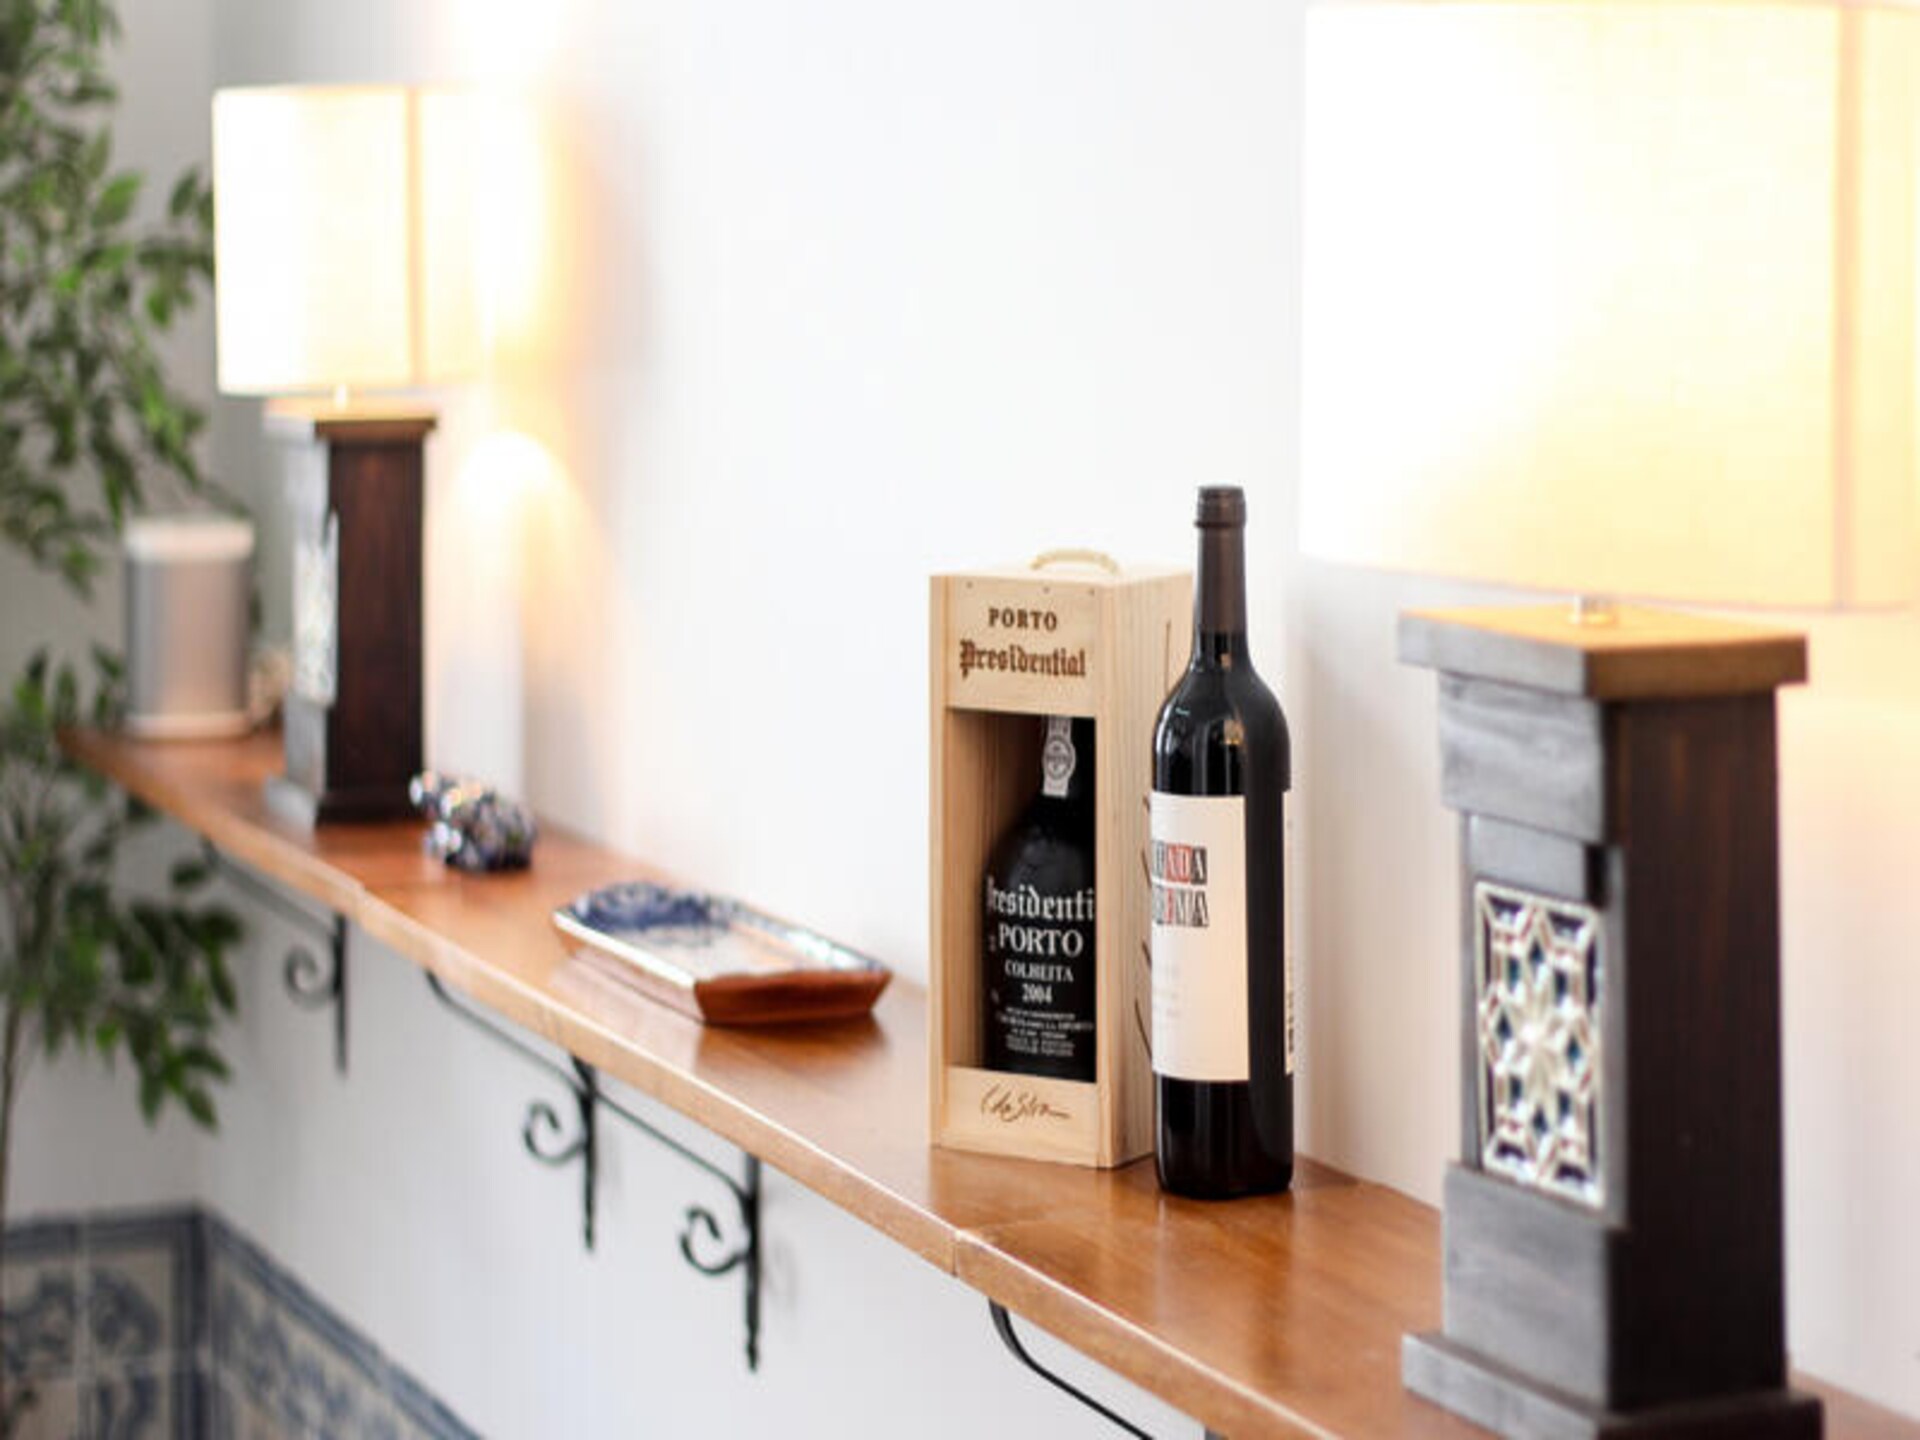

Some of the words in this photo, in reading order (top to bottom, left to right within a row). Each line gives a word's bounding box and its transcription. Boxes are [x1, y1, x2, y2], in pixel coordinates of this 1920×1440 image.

[988, 607, 1058, 632] PORTO
[959, 638, 1087, 681] Presidential
[986, 875, 1095, 920] residenti
[998, 921, 1084, 957] PORTO
